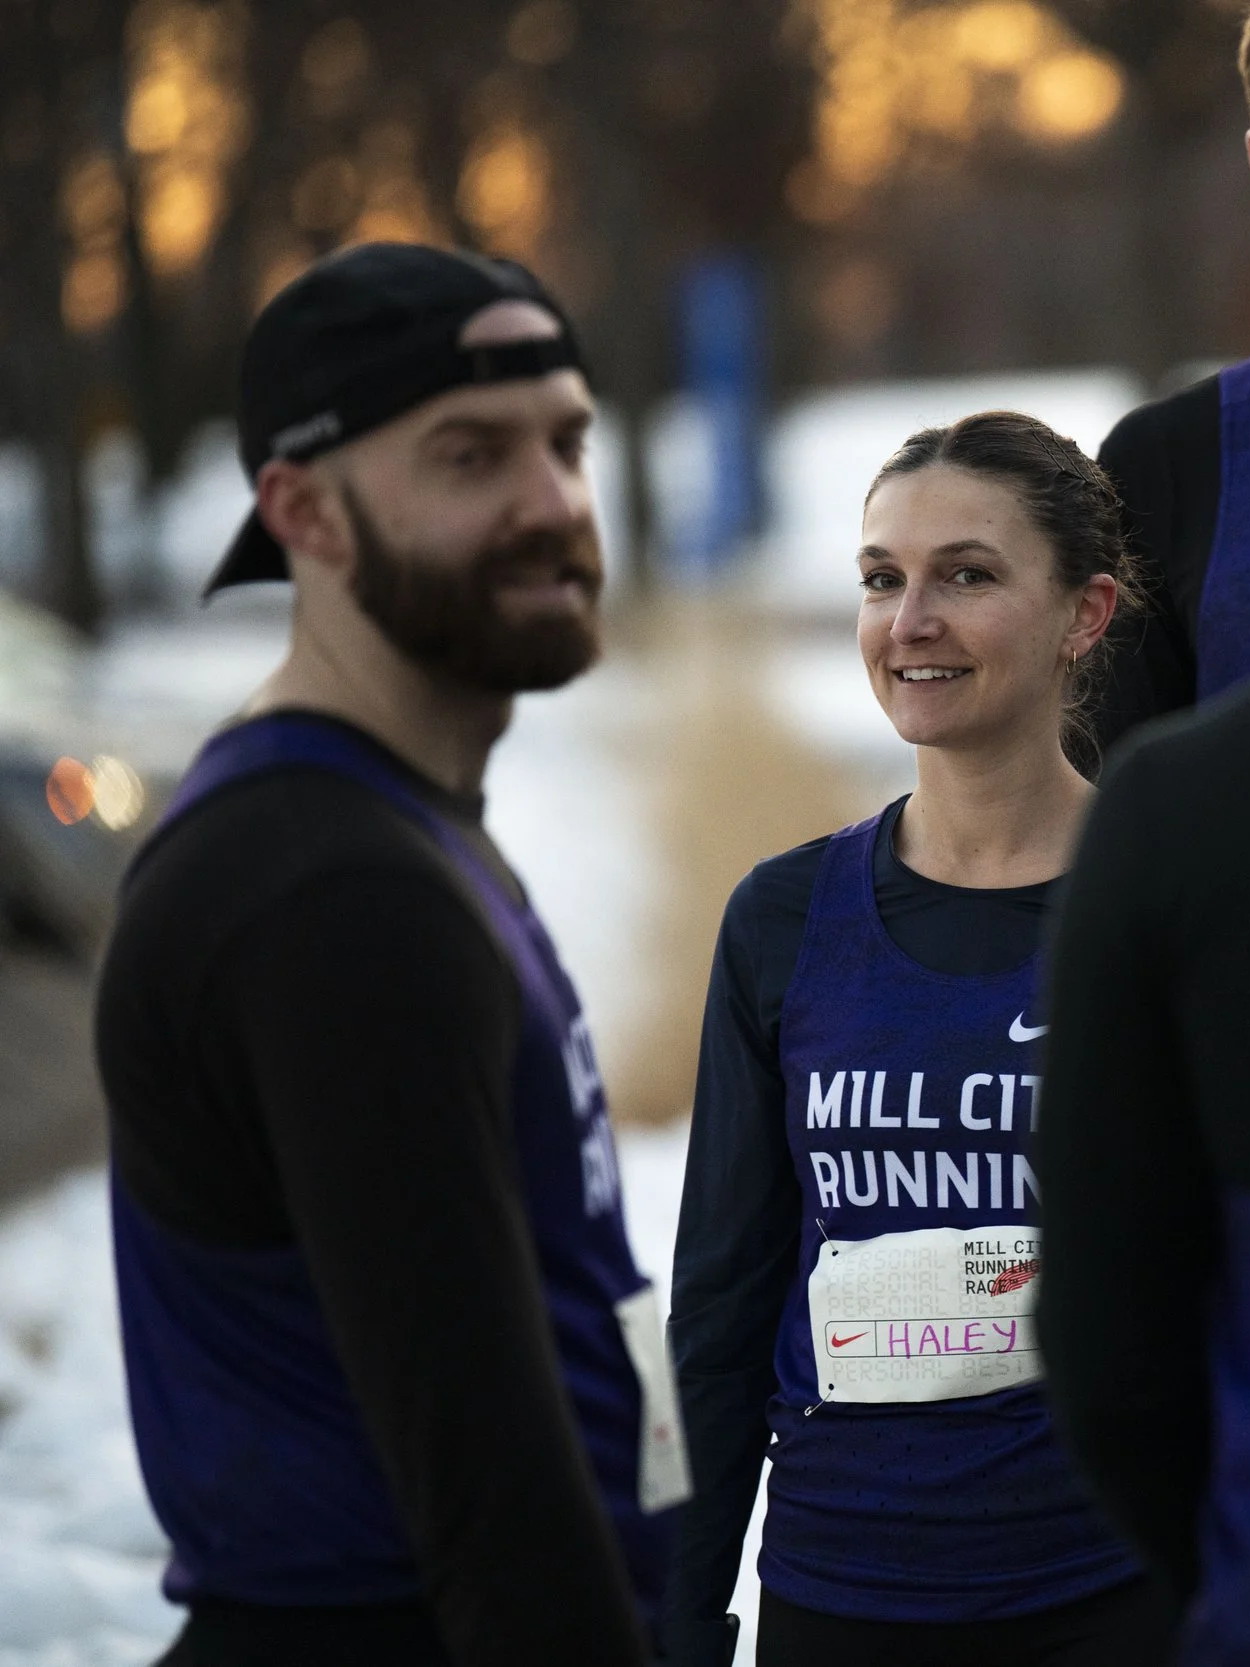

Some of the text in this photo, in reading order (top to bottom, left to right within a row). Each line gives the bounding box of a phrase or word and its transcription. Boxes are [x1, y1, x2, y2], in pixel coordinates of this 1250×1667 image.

[807, 1071, 1044, 1132] MILL CIT
[810, 1151, 1042, 1209] RUNNIN
[964, 1241, 1006, 1256] MILL
[828, 1294, 948, 1318] PERSONAL
[888, 1320, 1016, 1359] HALEY
[832, 1354, 1027, 1382] PERSONAL BEST
